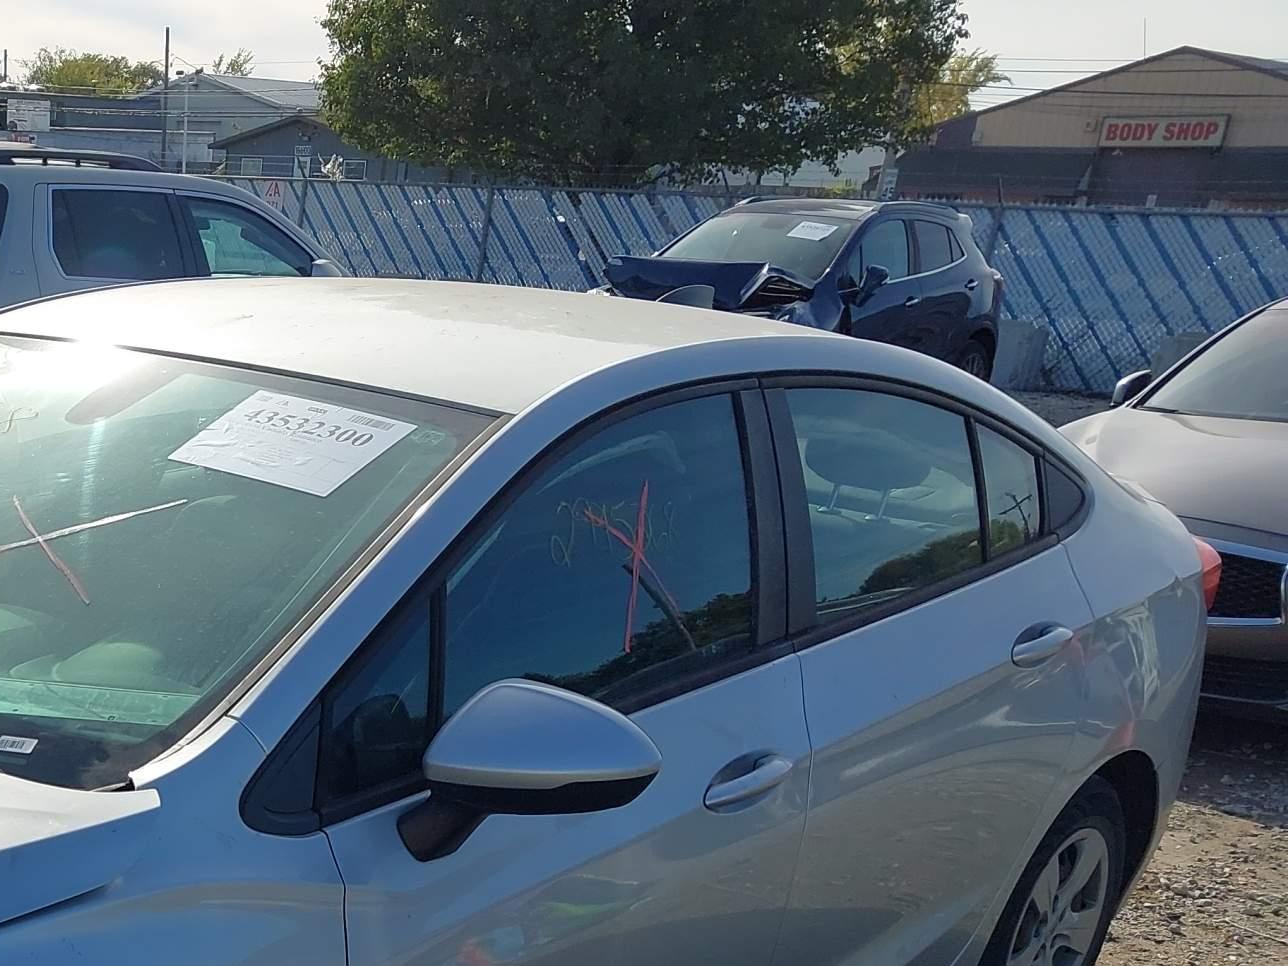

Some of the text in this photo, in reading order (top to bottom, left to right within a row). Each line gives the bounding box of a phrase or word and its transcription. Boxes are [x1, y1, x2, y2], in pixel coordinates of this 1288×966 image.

[1105, 121, 1219, 141] BODY SHOP
[243, 408, 374, 447] 43532300
